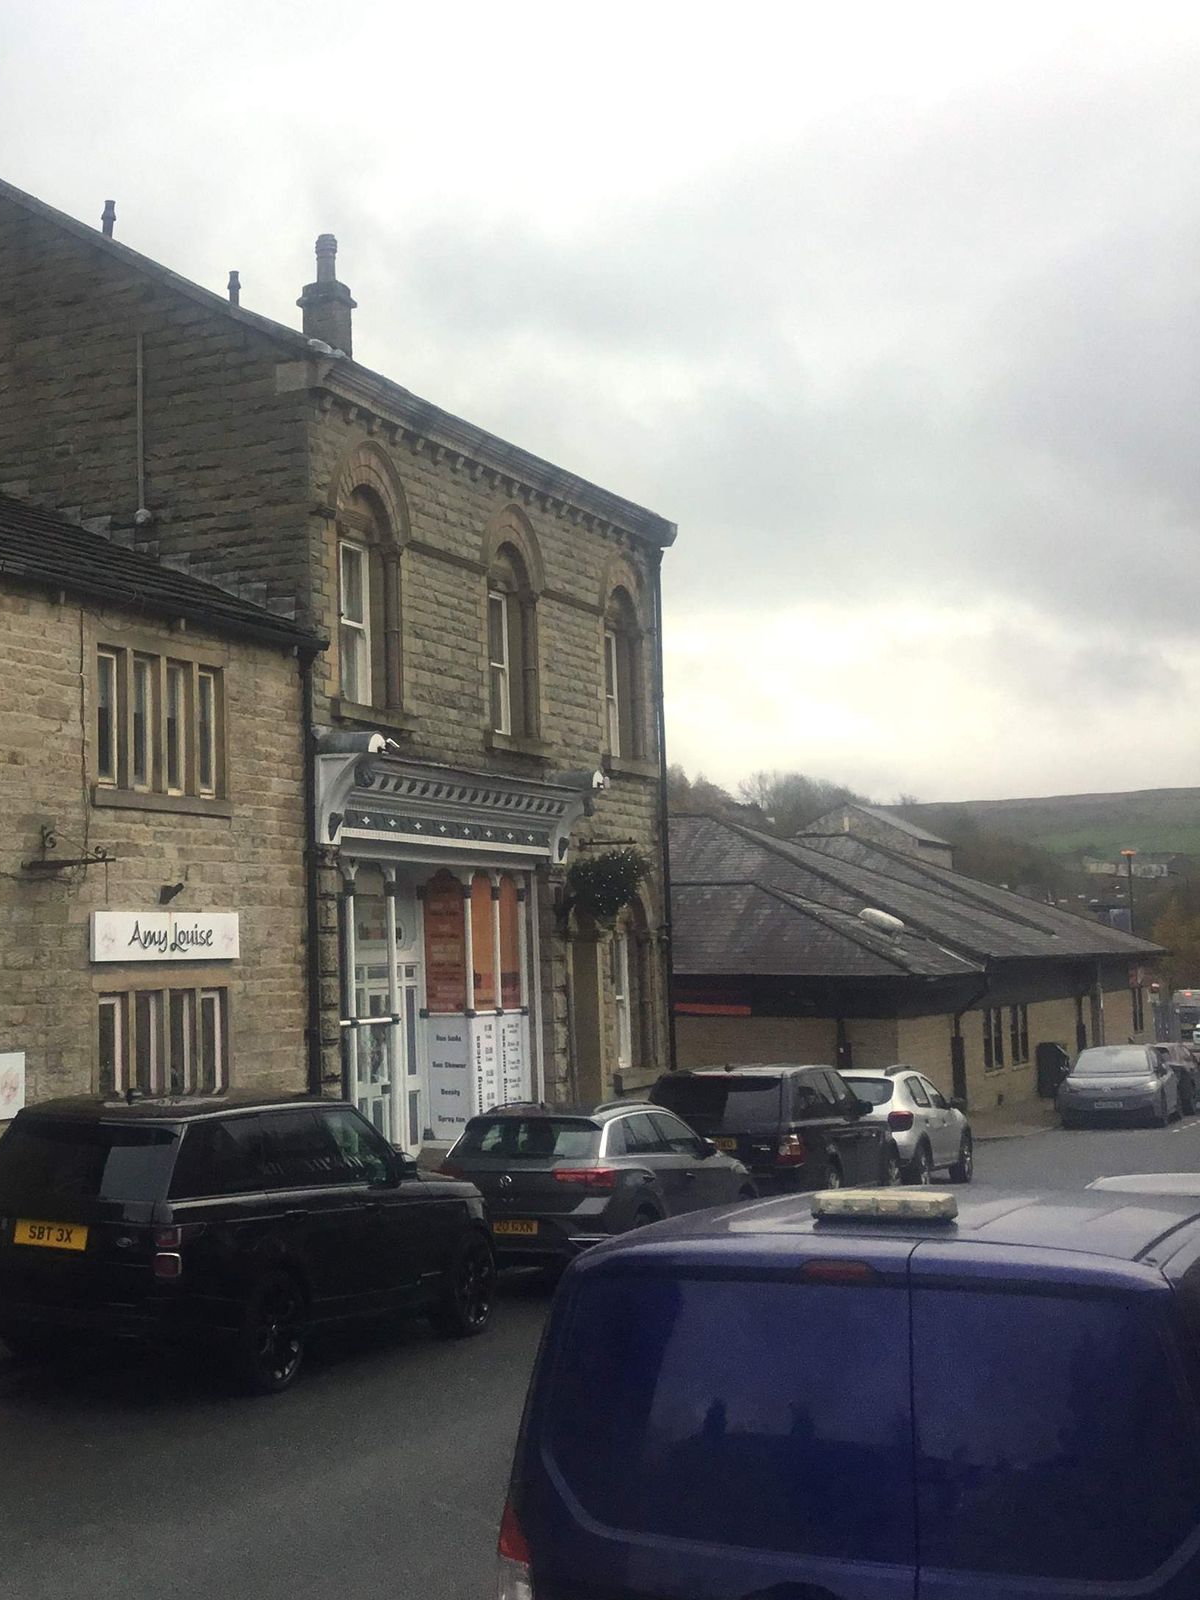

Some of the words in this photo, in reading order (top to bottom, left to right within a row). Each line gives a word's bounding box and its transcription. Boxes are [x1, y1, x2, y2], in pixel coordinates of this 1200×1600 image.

[127, 920, 168, 953] Amy
[169, 922, 214, 952] Louise
[28, 1225, 53, 1241] SBT
[55, 1228, 73, 1243] 3X
